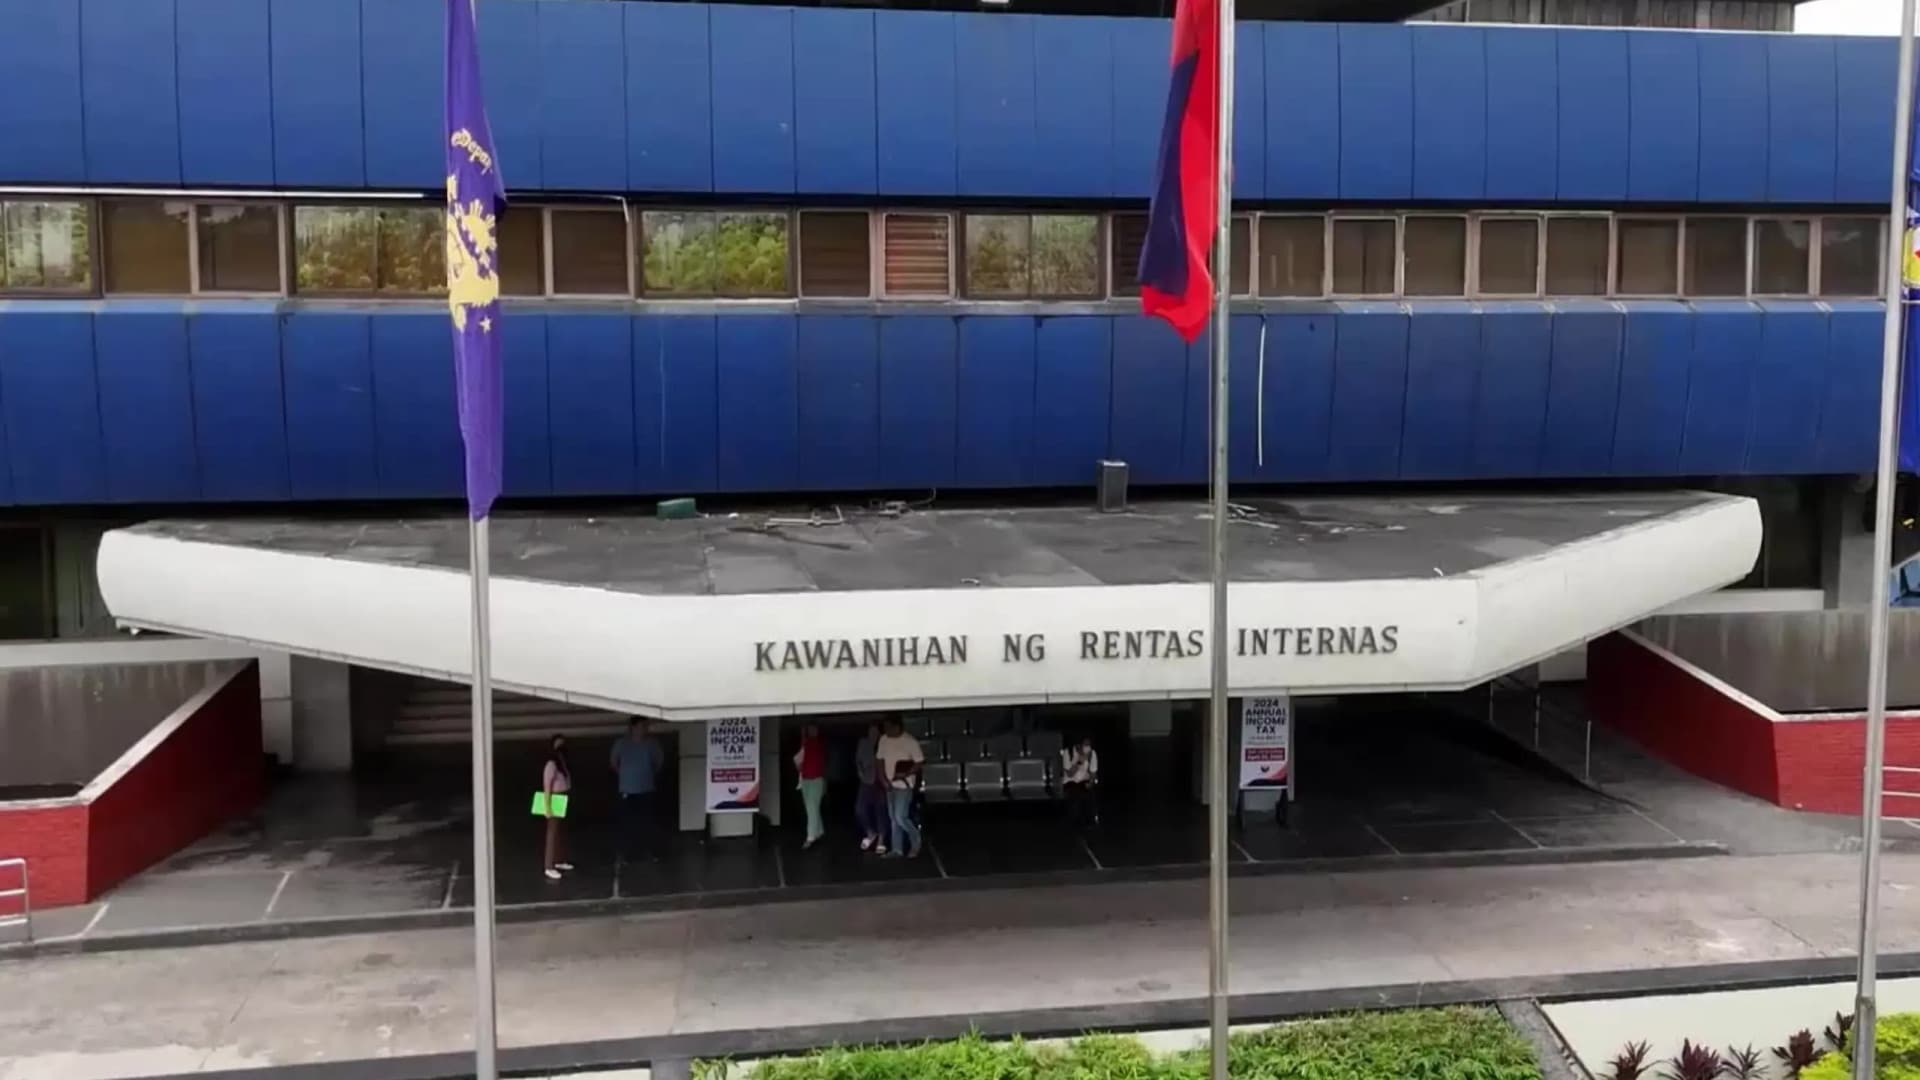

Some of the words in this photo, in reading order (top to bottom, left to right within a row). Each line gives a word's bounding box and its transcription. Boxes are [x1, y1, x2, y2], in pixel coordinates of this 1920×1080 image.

[754, 634, 968, 671] KAWANIHAN
[1003, 634, 1045, 662] NG
[1080, 630, 1204, 659] RENTAS
[1237, 625, 1399, 656] INTERNAS
[1246, 707, 1286, 717] ANNUAL
[1246, 716, 1286, 726] INCOME
[710, 726, 757, 735] ANNUAL
[1256, 726, 1276, 734] TAX
[710, 735, 756, 745] INCOME
[723, 745, 744, 754] TAX
